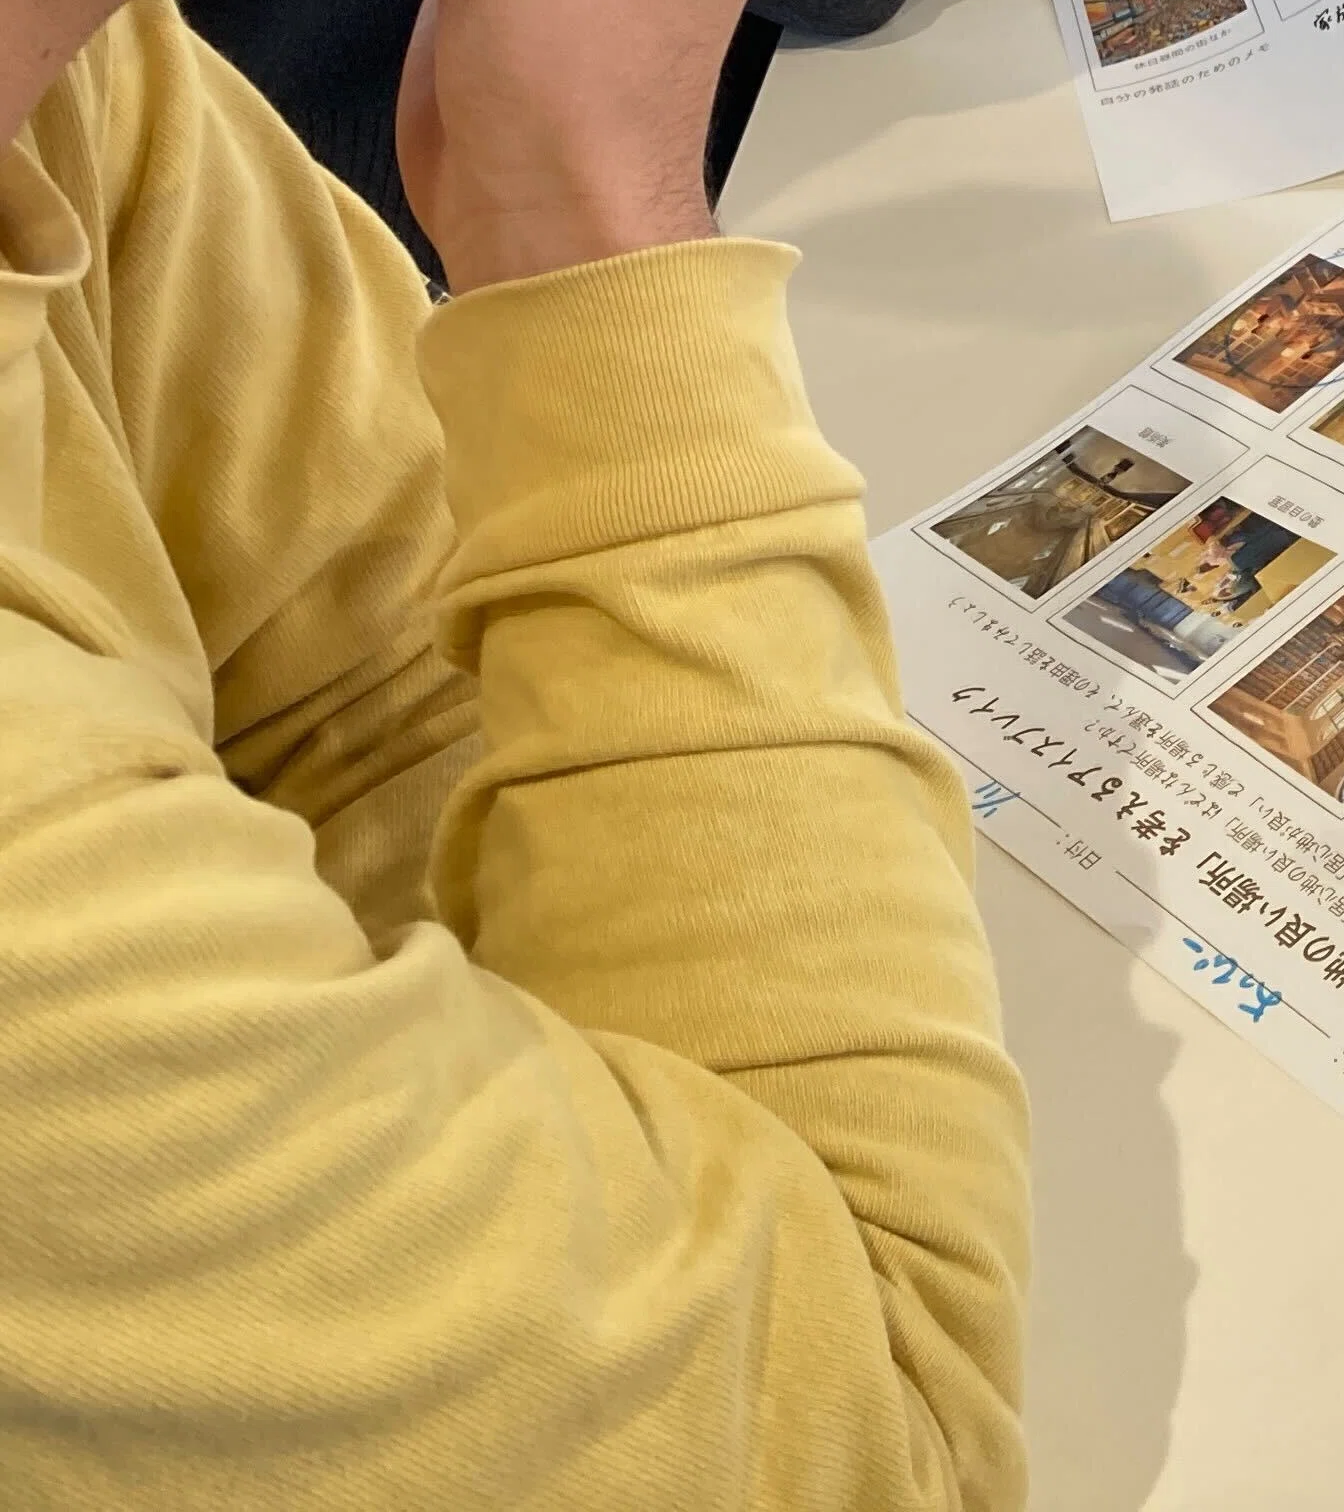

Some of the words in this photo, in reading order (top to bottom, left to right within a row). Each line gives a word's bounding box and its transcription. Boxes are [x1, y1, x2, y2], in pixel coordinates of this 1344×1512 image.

[1267, 493, 1326, 529] 塾の自習室
